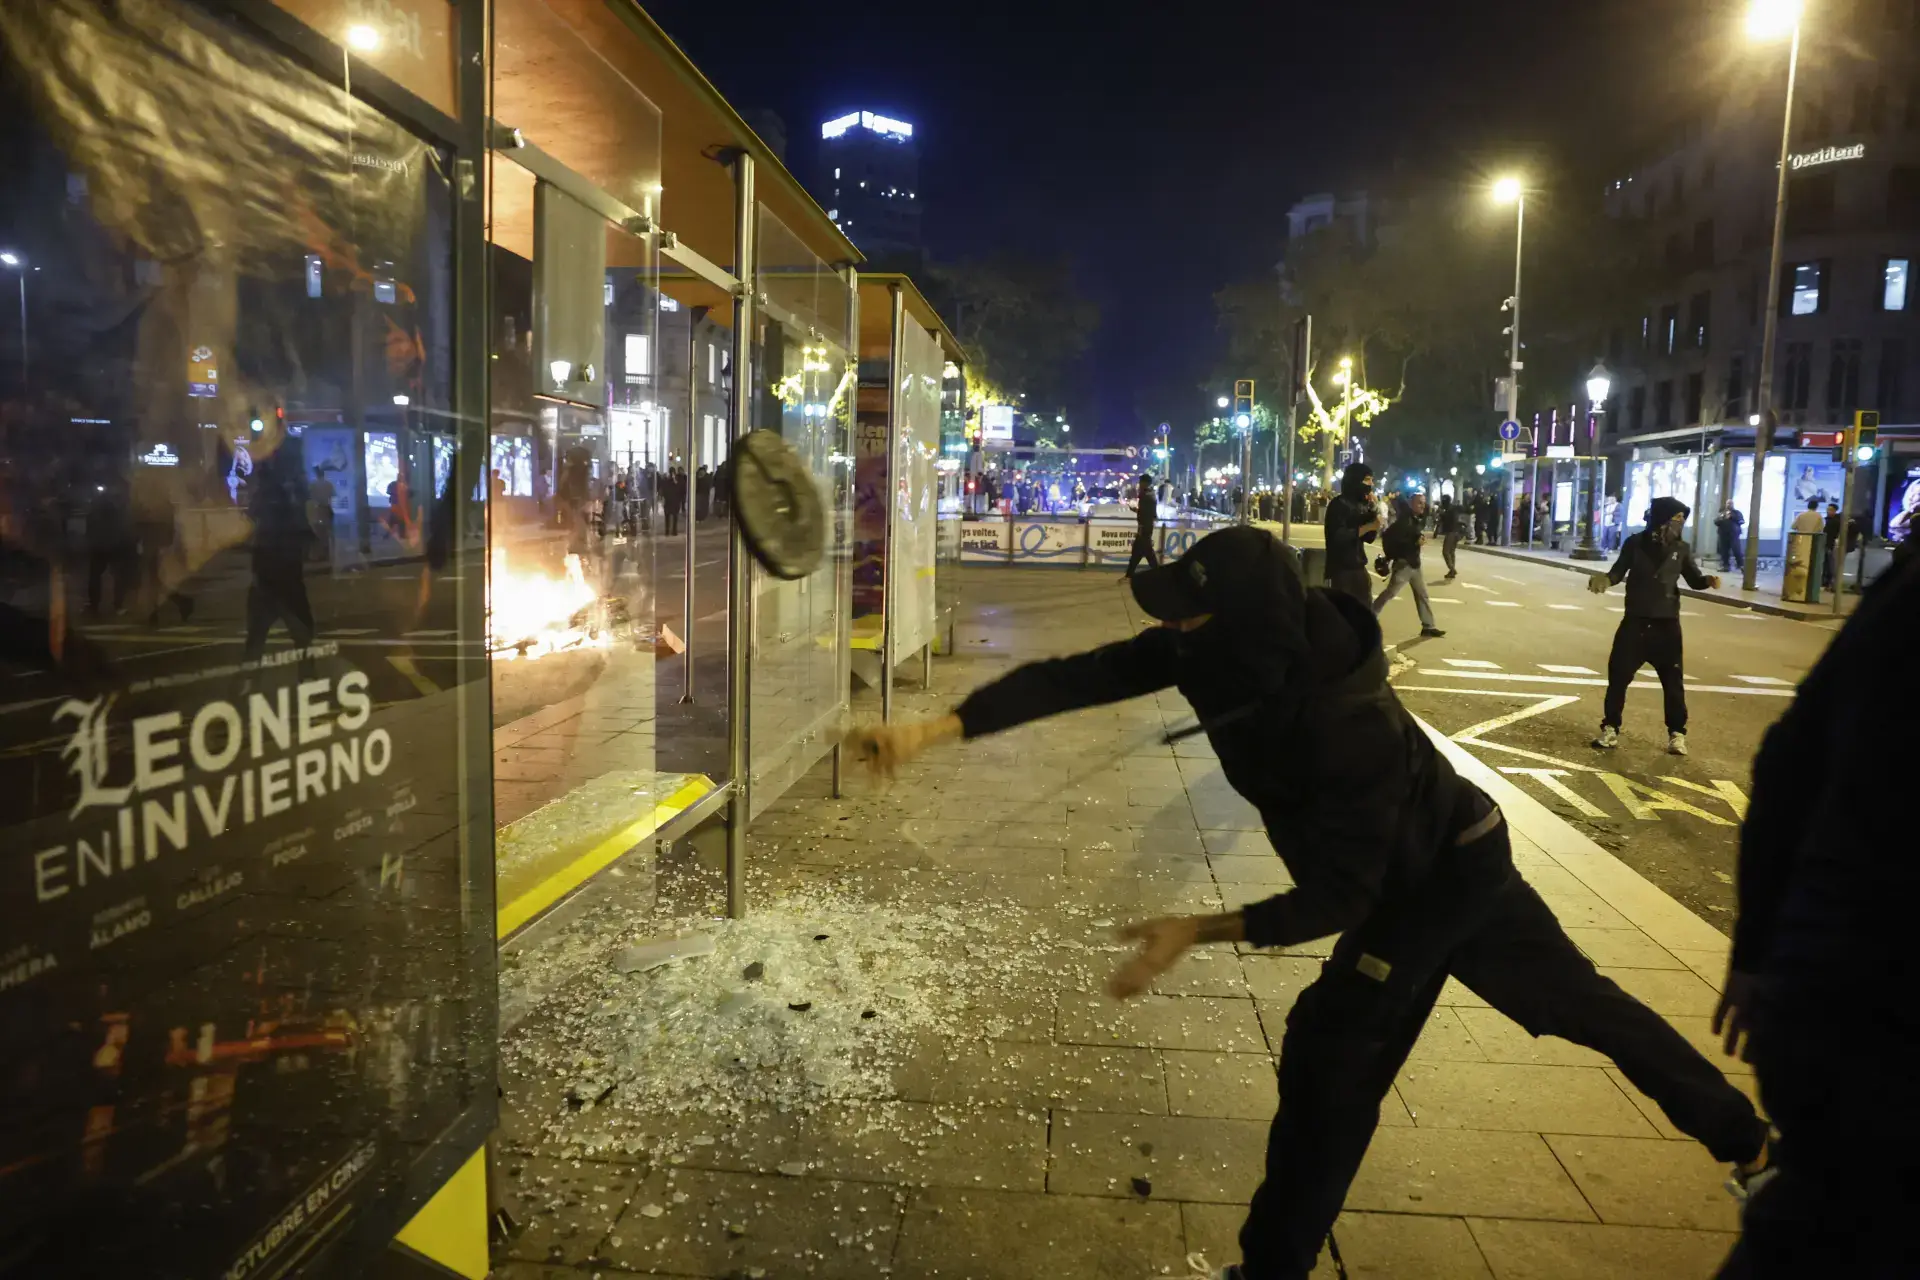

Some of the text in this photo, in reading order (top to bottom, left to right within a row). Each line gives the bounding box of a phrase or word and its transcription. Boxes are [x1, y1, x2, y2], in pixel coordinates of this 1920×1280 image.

[1792, 143, 1865, 169] Occident
[1119, 530, 1137, 538] entra
[51, 670, 371, 821] LEONES
[34, 728, 393, 903] EN INVIERNO
[176, 871, 243, 910] CALLEJO
[305, 1181, 329, 1215] EN
